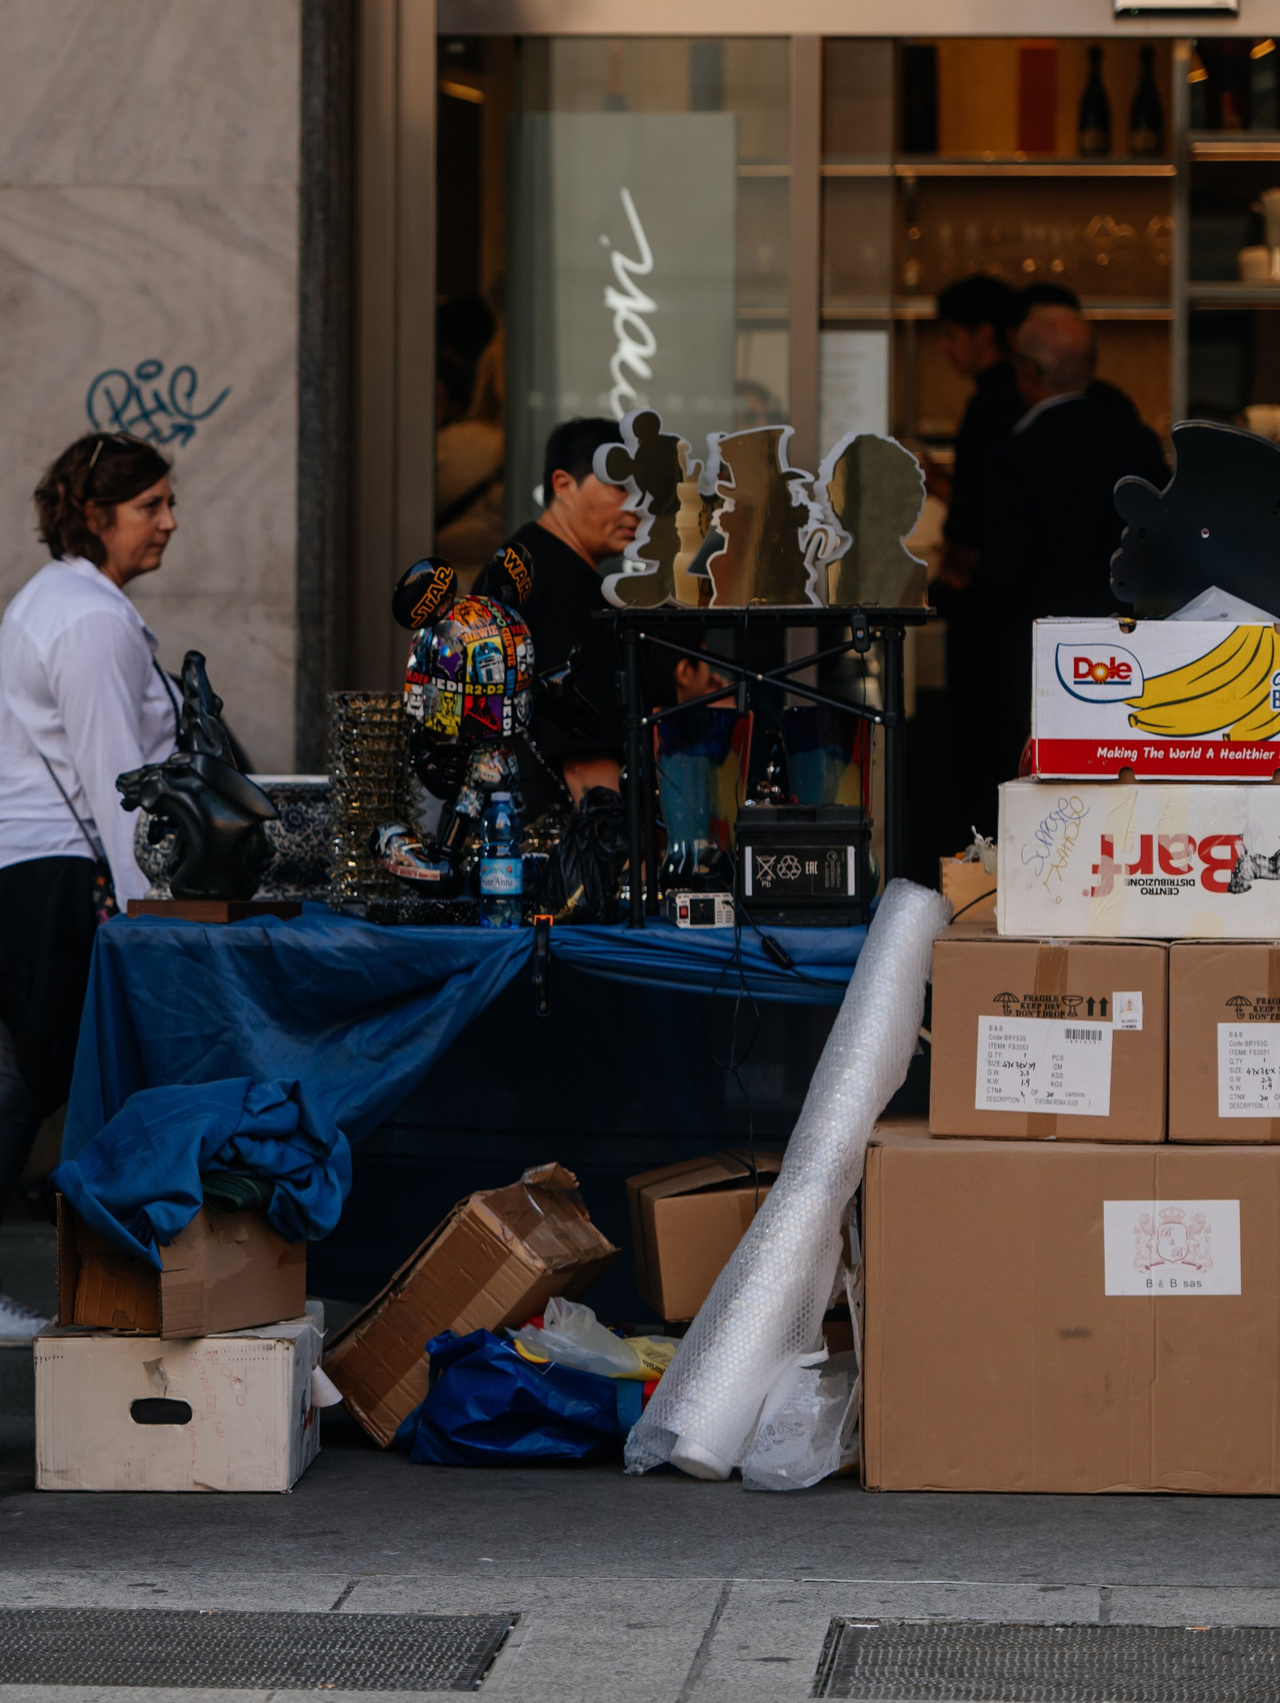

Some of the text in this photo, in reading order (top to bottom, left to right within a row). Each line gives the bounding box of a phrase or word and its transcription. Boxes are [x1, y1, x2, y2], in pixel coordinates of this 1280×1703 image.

[410, 566, 454, 629] STAR
[1073, 656, 1133, 683] Dole
[503, 696, 512, 737] JEDI
[1097, 746, 1276, 762] Making The World A Healthier
[1091, 834, 1243, 897] Barf
[1140, 887, 1180, 896] CENTRO
[1052, 1054, 1065, 1062] PCS
[1051, 1072, 1064, 1080] KGS
[1146, 1279, 1202, 1288] B & B sas
